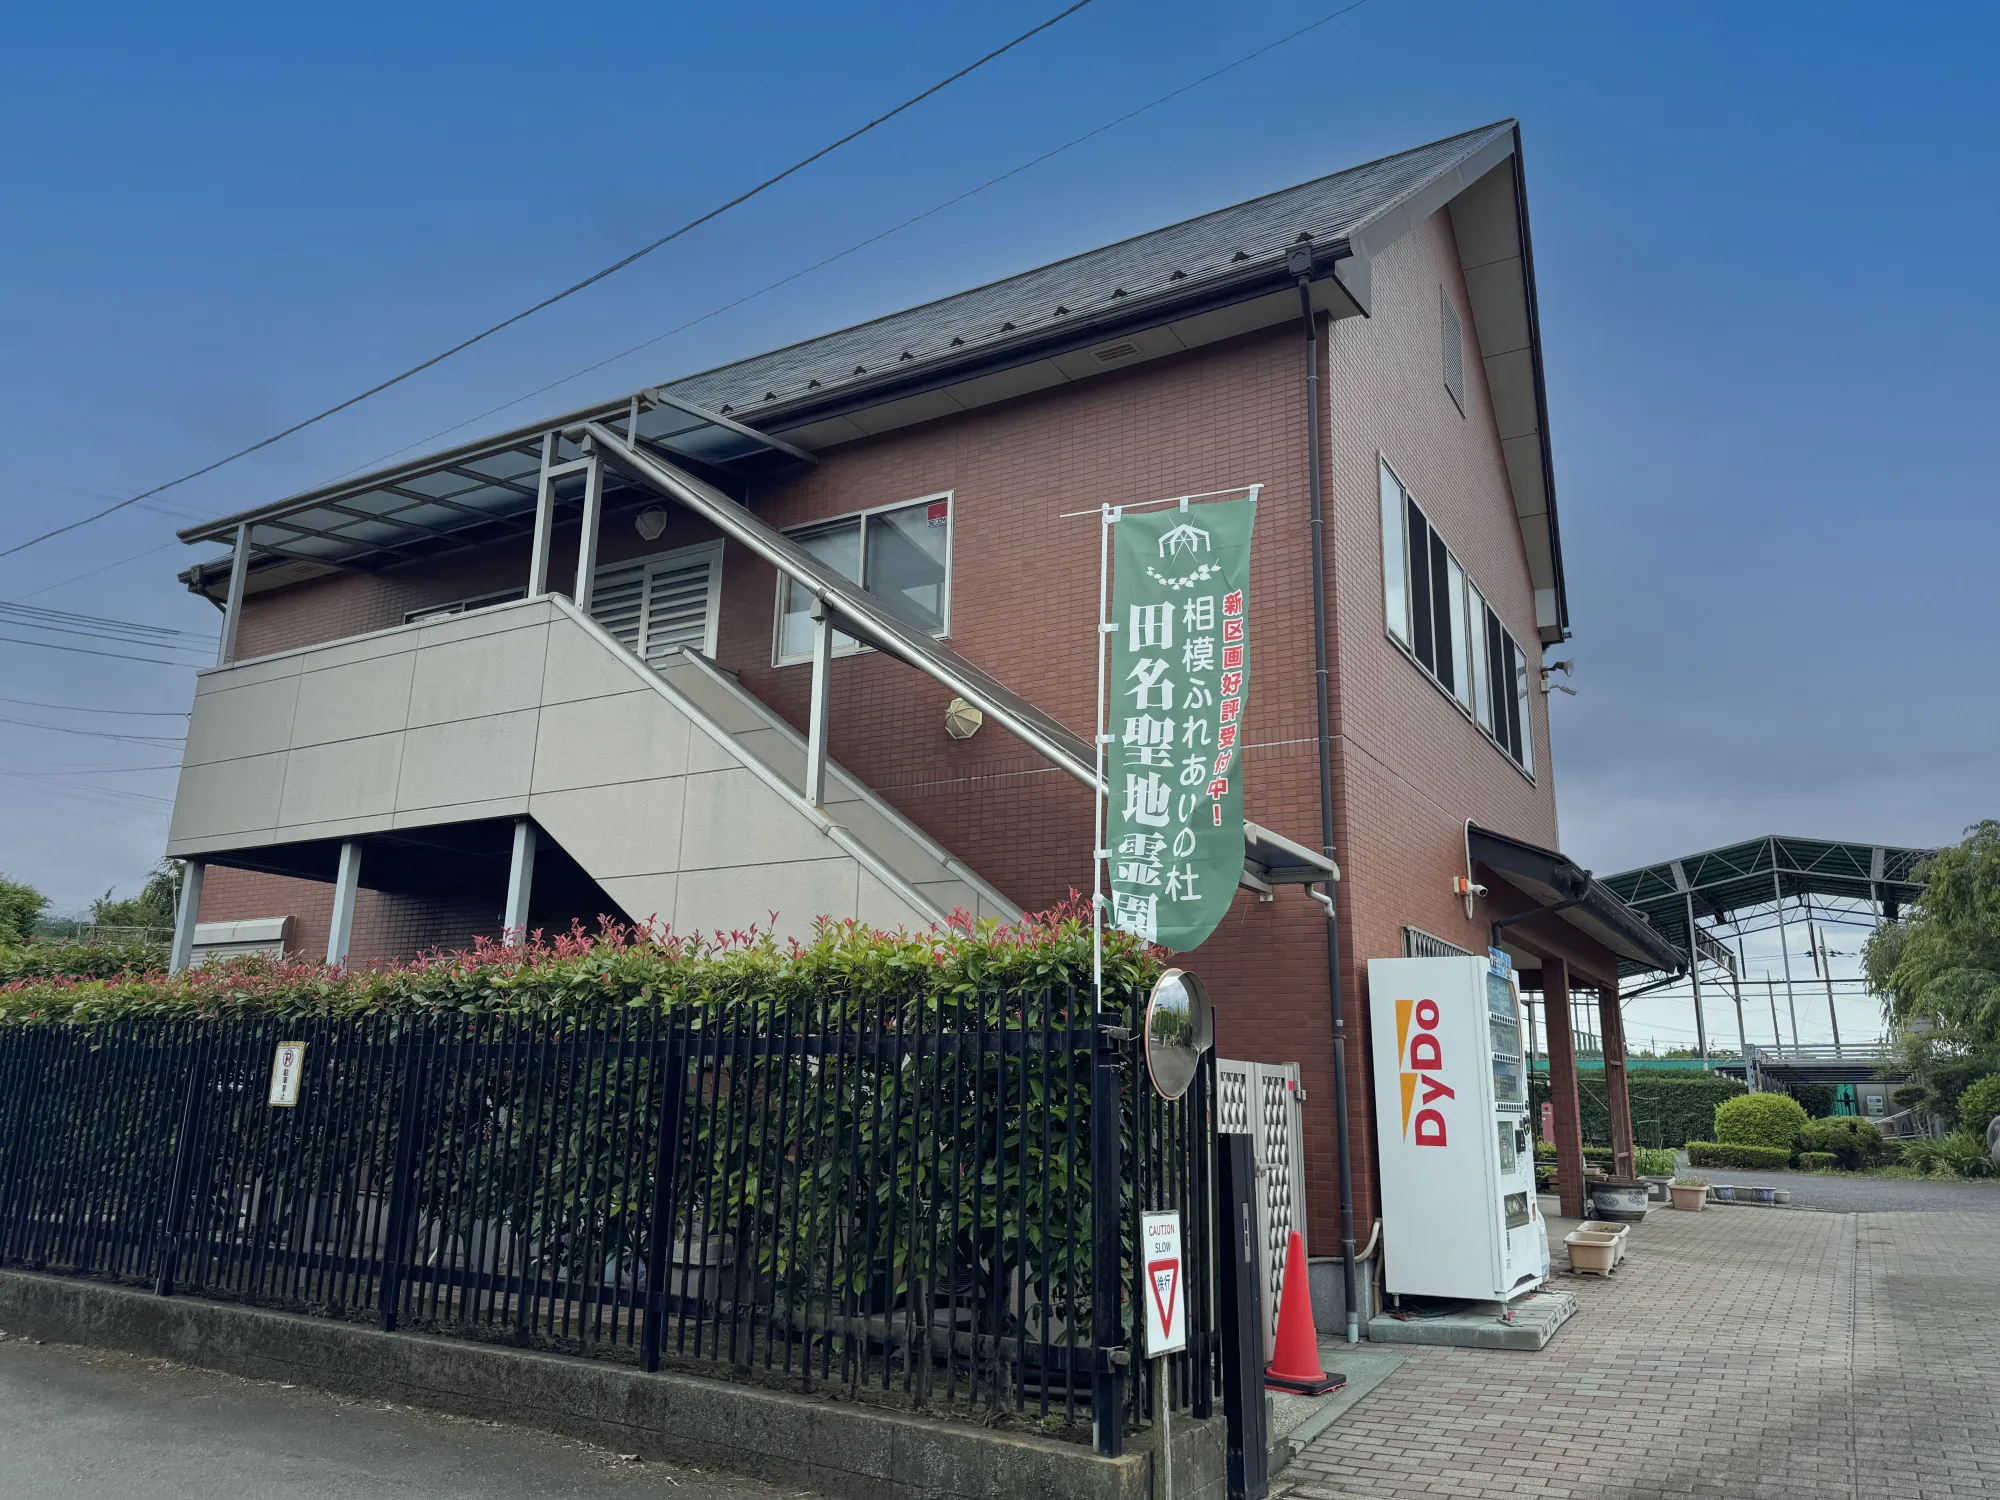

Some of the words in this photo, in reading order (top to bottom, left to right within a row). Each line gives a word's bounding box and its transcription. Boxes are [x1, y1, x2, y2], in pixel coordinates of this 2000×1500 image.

[1112, 601, 1176, 943] 田名聖地霊園
[1165, 596, 1215, 902] 相模ふれあいの杜
[1207, 590, 1243, 826] 新区画好評受付中!
[1410, 998, 1455, 1147] DyDo
[1148, 1223, 1175, 1237] CAUTION
[1154, 1241, 1172, 1254] SLOW
[1157, 1274, 1171, 1293] 徐行
